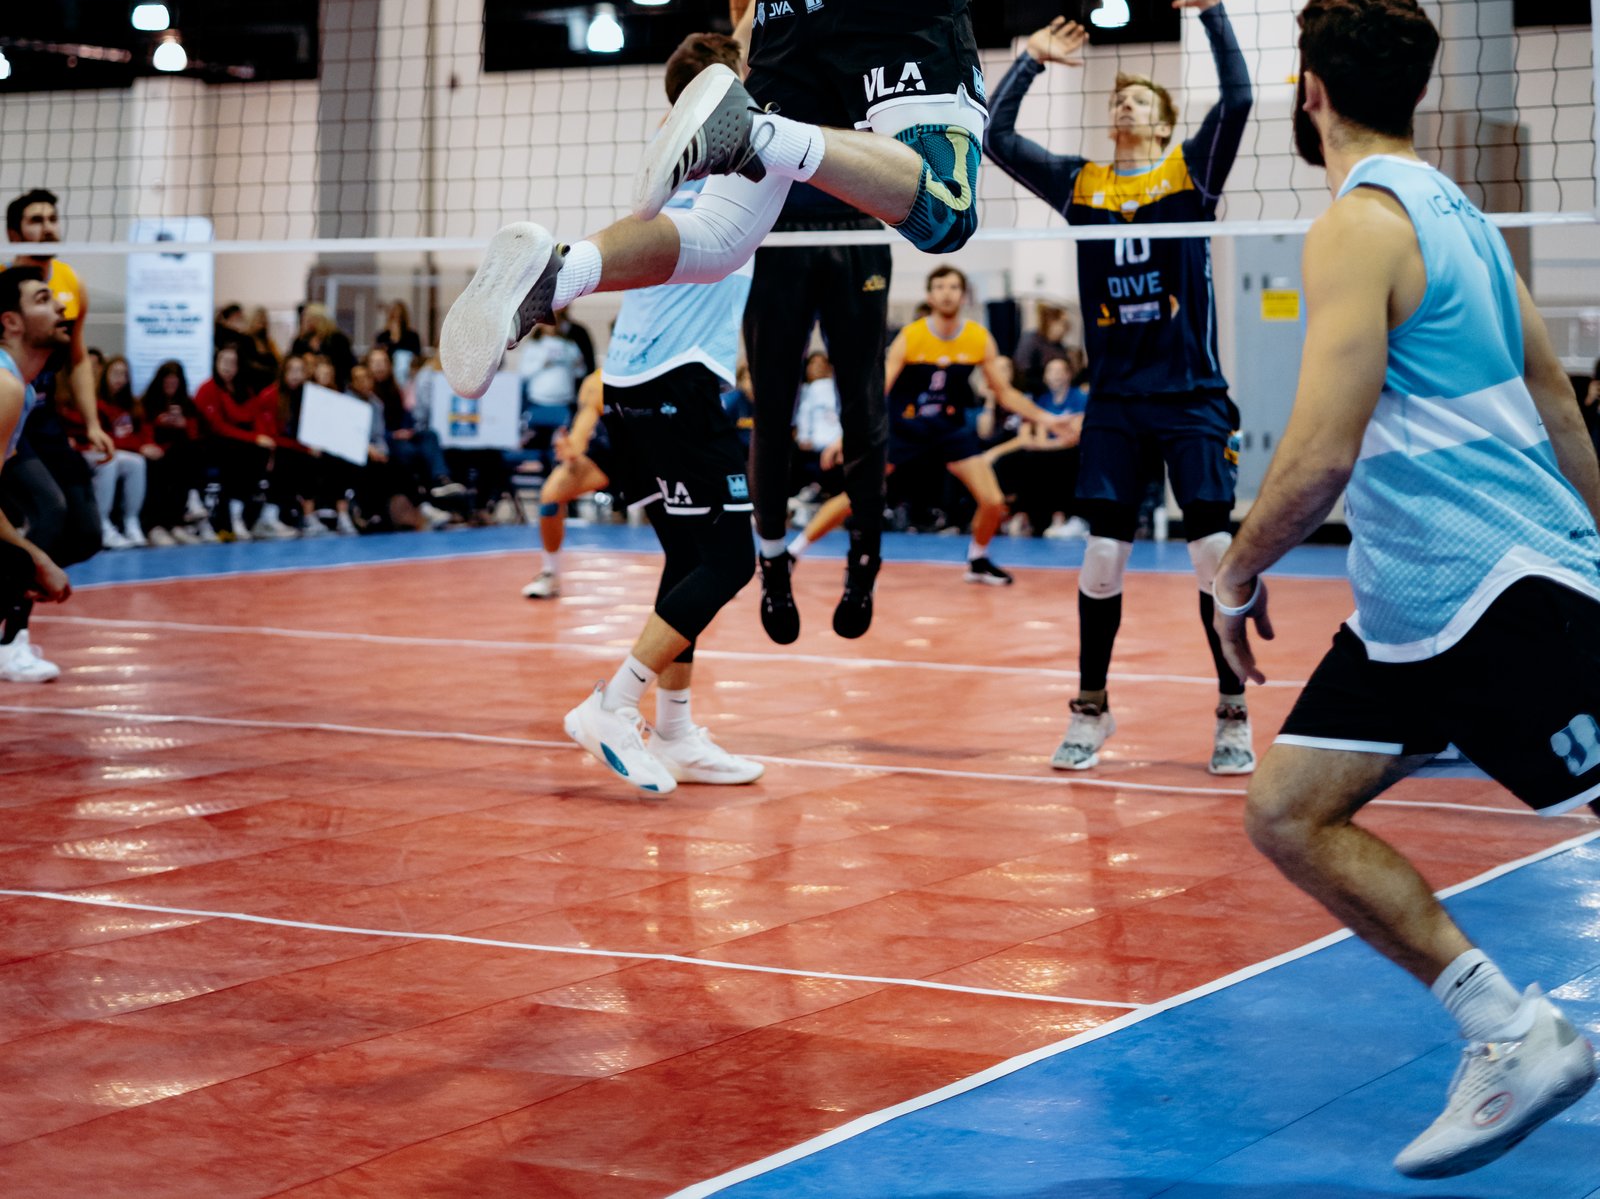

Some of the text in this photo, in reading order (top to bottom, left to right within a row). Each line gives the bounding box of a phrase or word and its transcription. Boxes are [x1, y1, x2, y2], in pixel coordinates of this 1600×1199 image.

[769, 0, 795, 17] JVA
[863, 62, 926, 102] VLA
[1107, 271, 1163, 298] DIVE
